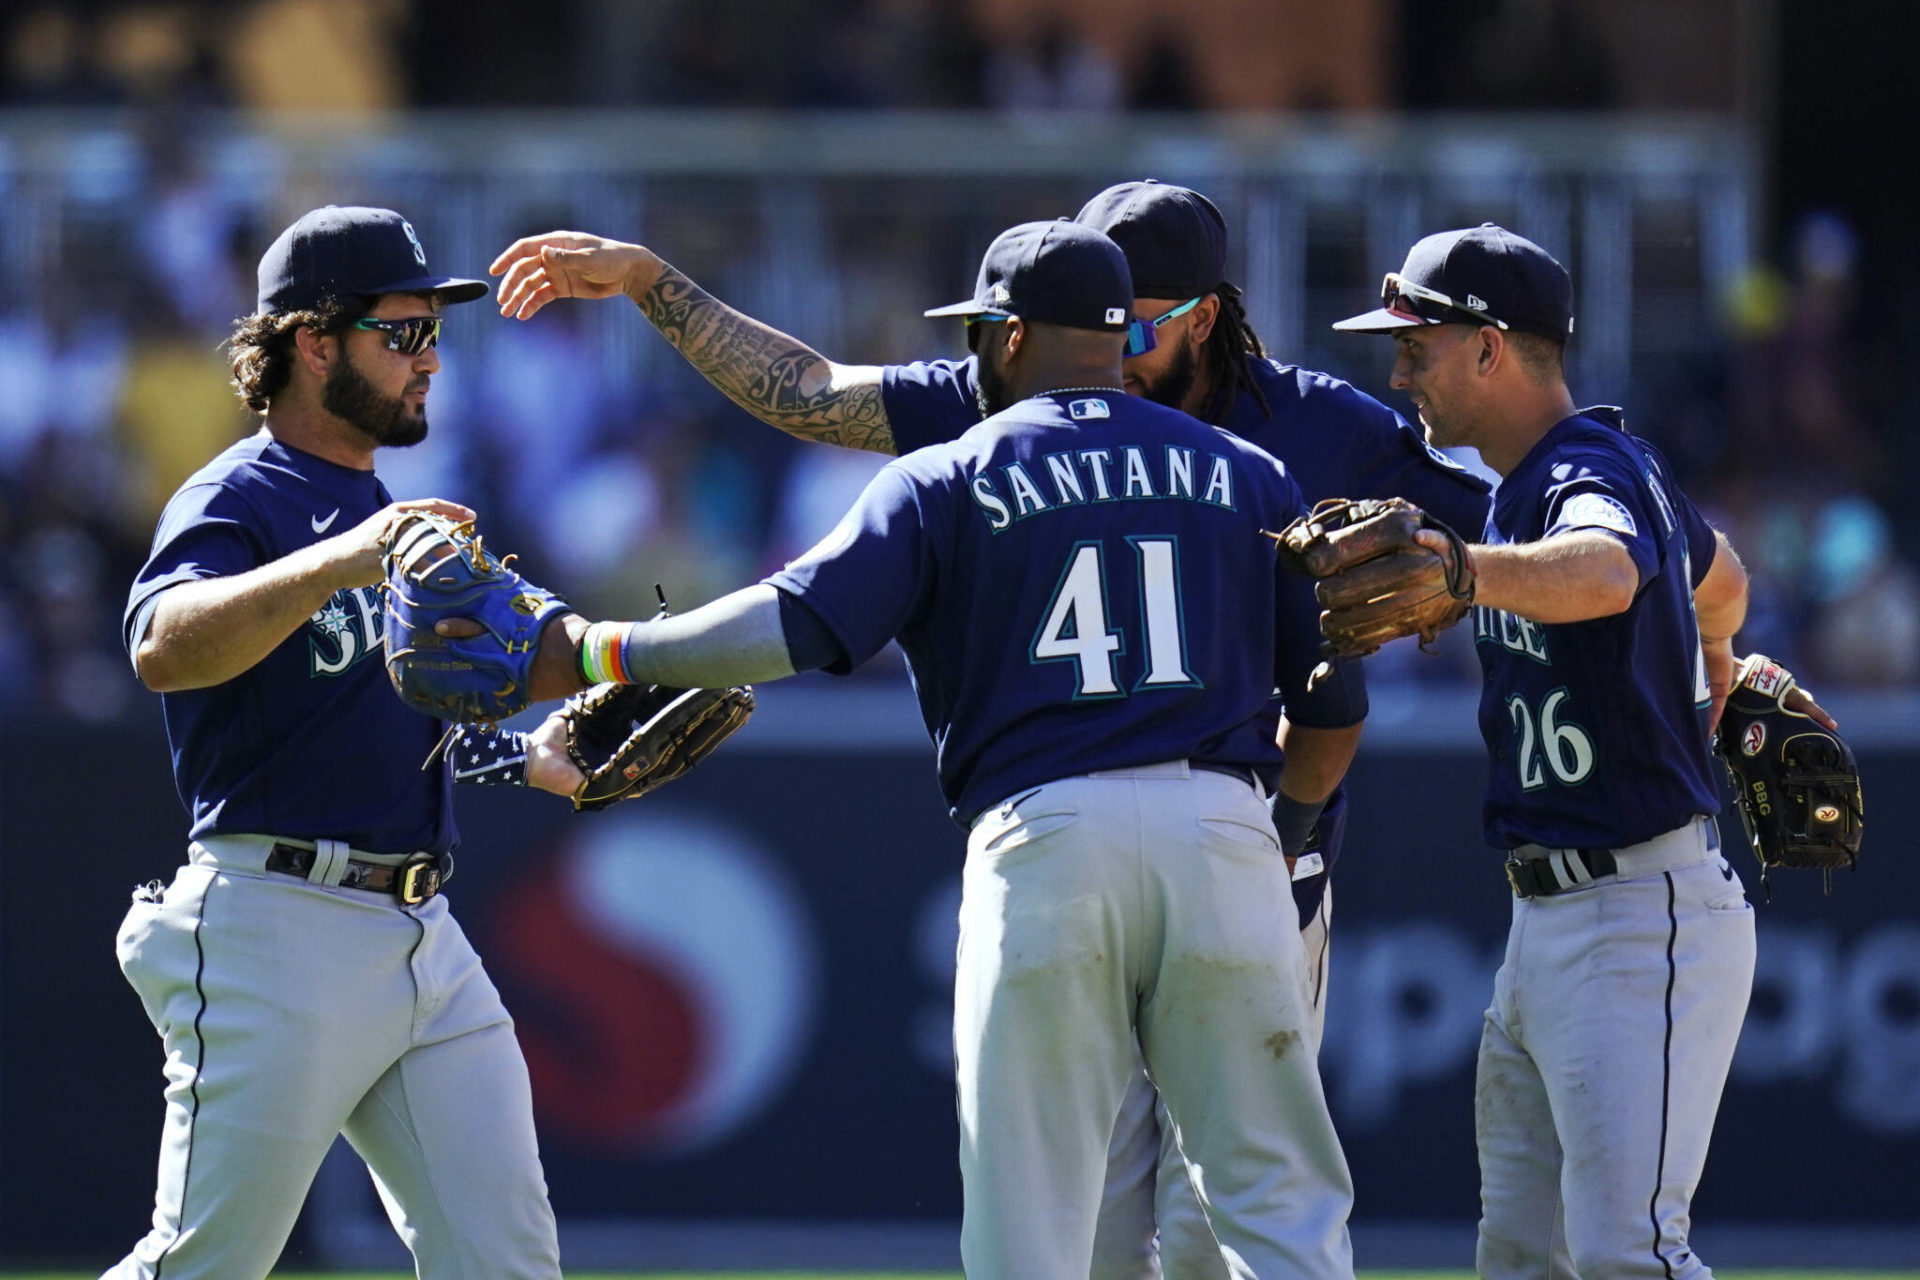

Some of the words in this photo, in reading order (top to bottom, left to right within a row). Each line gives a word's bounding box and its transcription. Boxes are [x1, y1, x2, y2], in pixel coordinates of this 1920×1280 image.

[969, 444, 1237, 535] SANTANA
[1029, 534, 1204, 700] 41
[1507, 686, 1597, 793] 26
